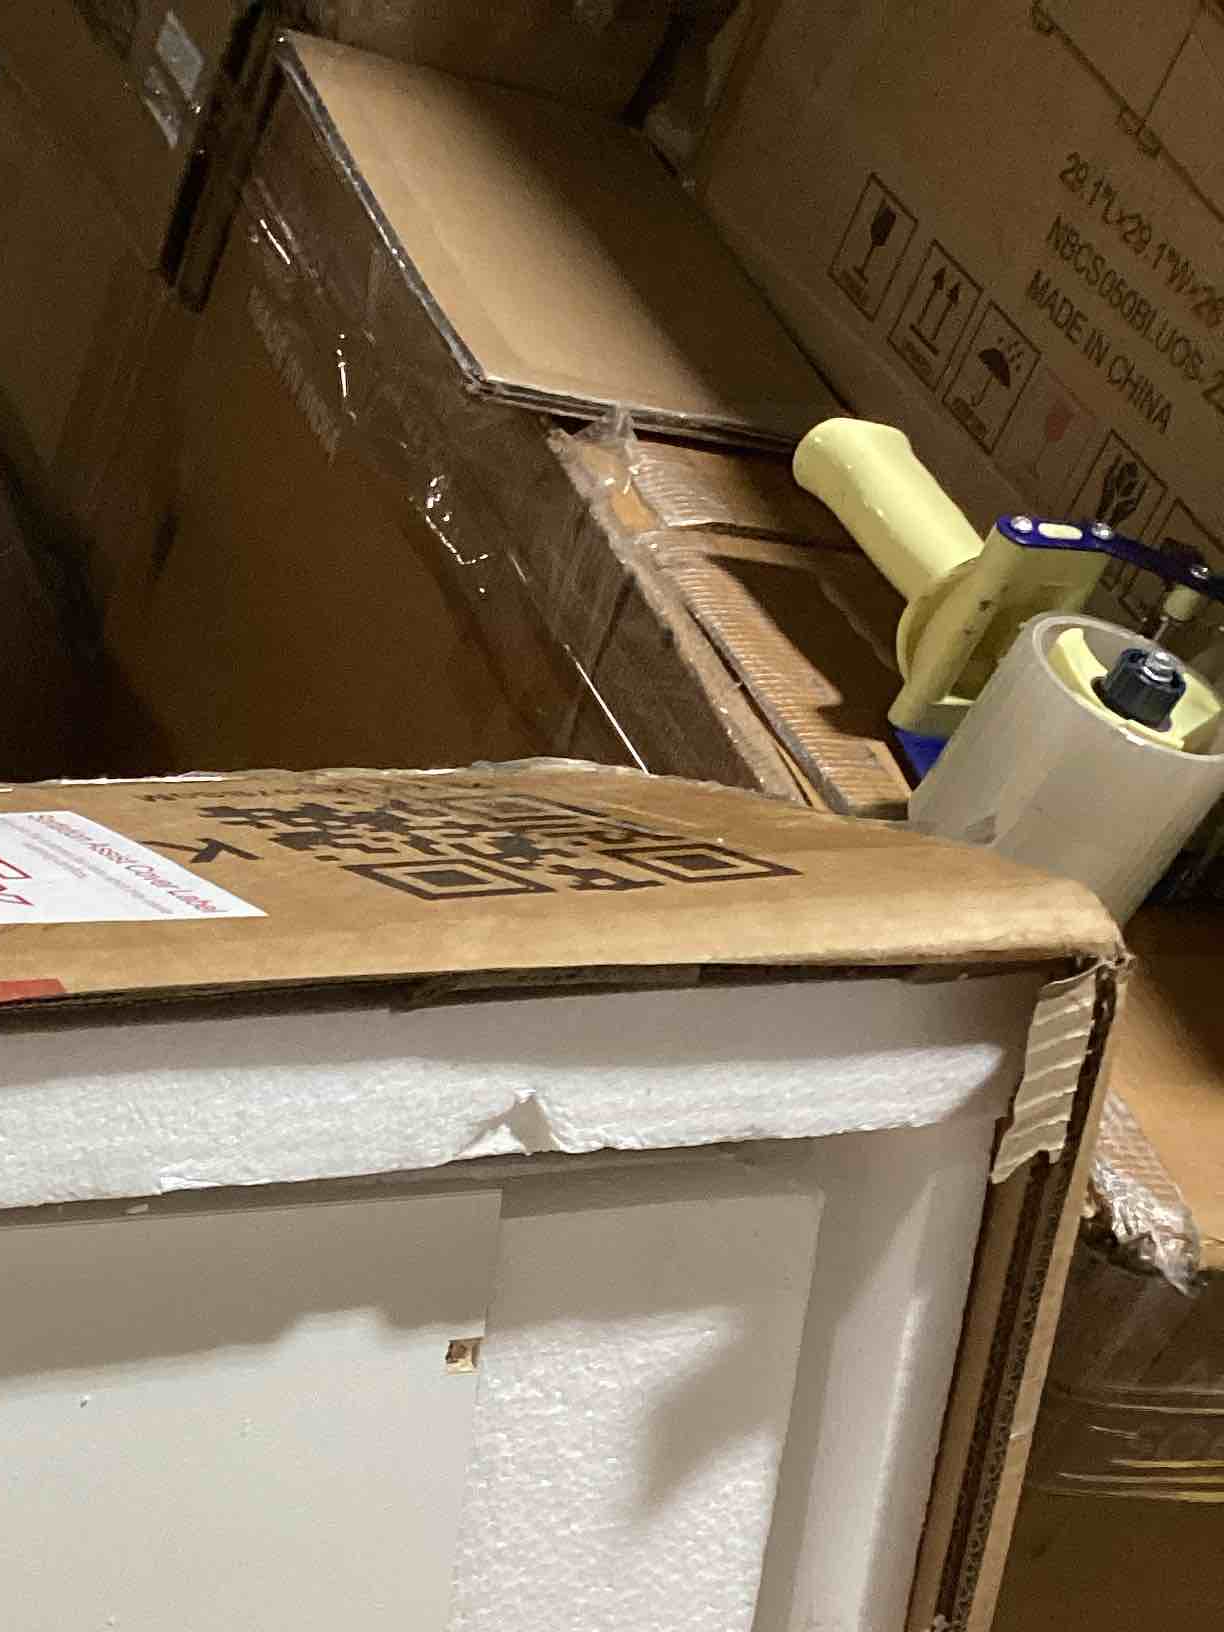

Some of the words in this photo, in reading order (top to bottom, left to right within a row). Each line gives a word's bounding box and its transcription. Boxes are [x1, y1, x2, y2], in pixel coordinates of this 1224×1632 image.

[1027, 268, 1088, 345] MADE
[1083, 328, 1113, 370] IN
[1105, 354, 1173, 435] CHINA
[125, 864, 179, 889] Cover
[168, 889, 230, 912] Label
